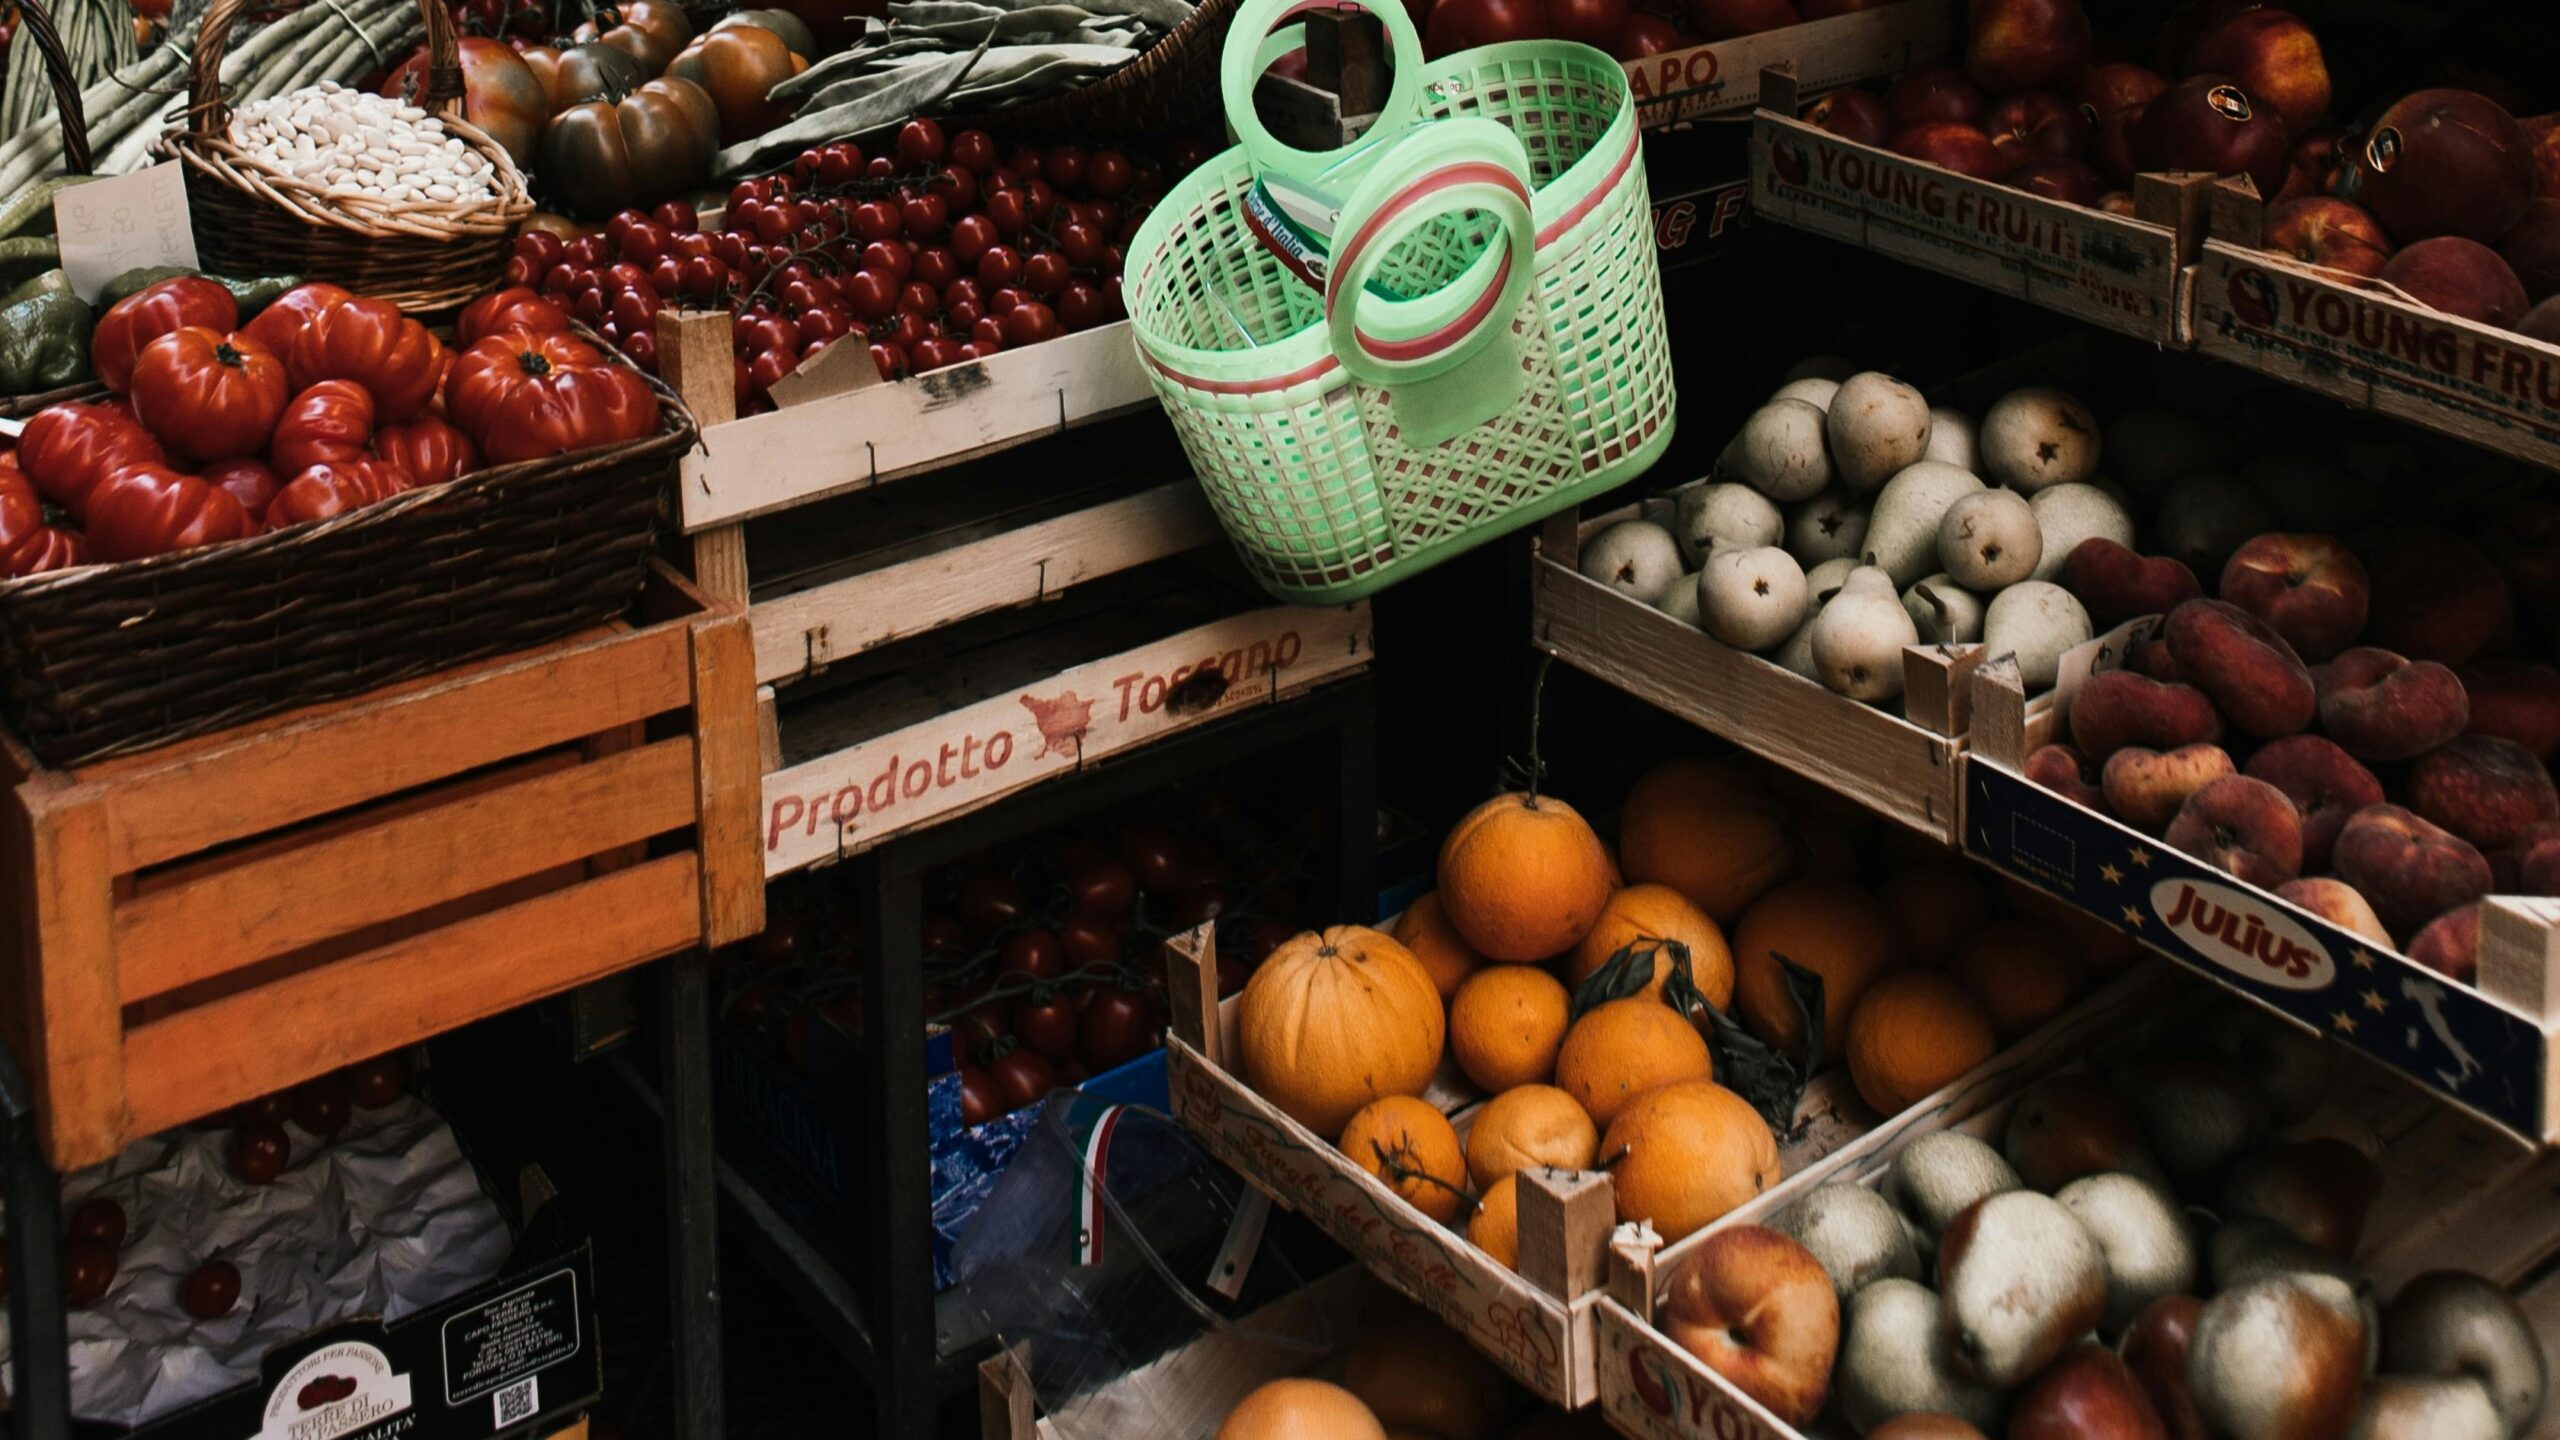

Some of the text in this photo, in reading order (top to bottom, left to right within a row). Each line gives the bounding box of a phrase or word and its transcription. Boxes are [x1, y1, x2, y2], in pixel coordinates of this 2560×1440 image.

[1818, 143, 1945, 219] YOUNG
[1263, 214, 1304, 258] d'Italia
[2285, 280, 2458, 376] YOUNG
[767, 730, 1014, 851] Prodotto
[1334, 1203, 1382, 1236] del
[501, 1290, 535, 1308] Agricola
[464, 1325, 490, 1342] CAPO
[491, 1307, 532, 1329] PASSERO
[323, 1347, 345, 1361] PER
[462, 1352, 516, 1382] PORTOPALO
[288, 1393, 370, 1438] TERRE DI
